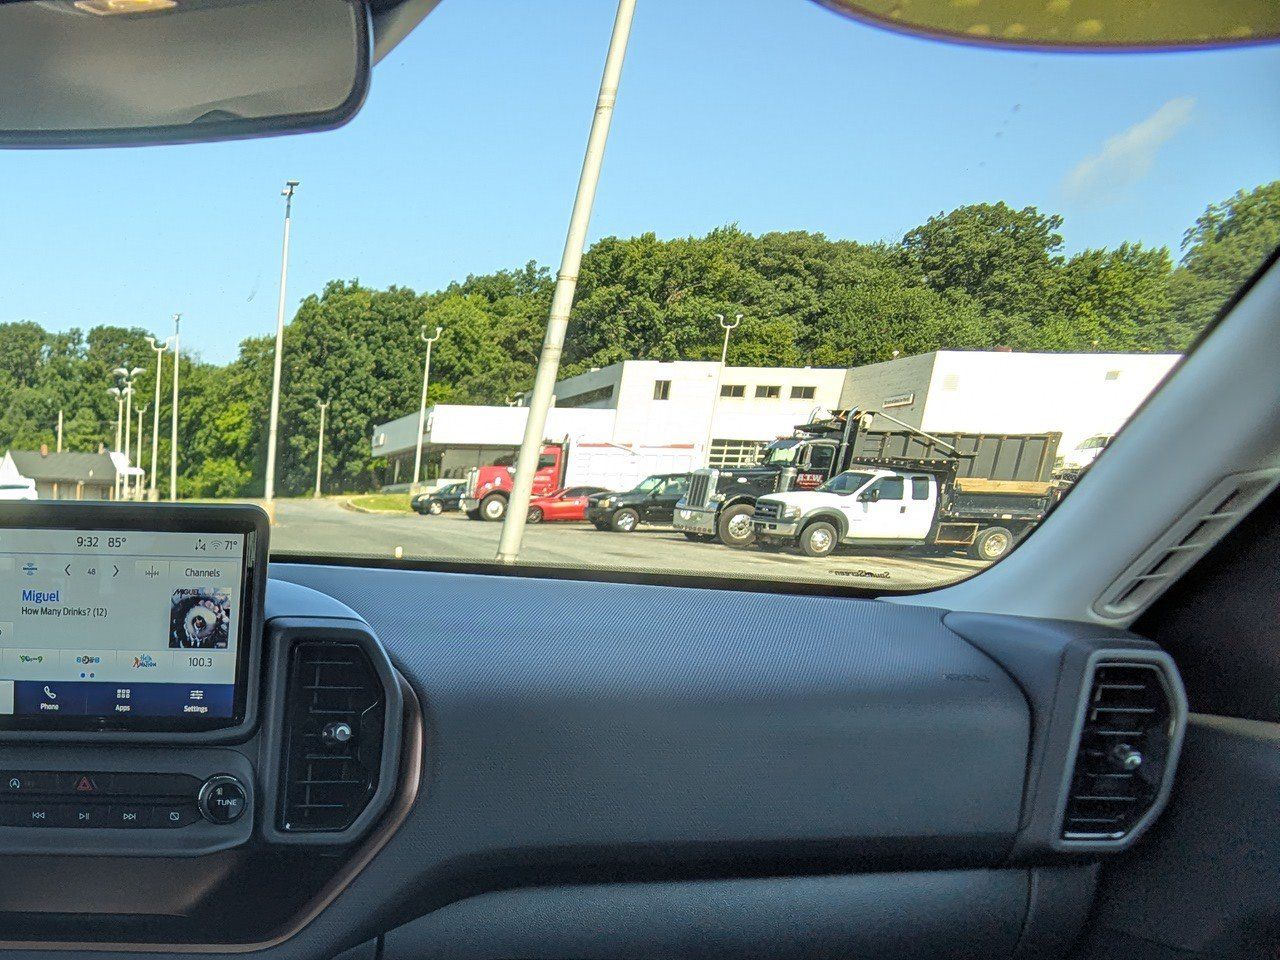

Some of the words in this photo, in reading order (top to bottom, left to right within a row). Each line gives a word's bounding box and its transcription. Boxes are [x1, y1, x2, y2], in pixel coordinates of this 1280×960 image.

[76, 536, 99, 547] 9:32
[107, 537, 127, 548] 85°
[224, 540, 238, 550] 71°
[87, 568, 96, 576] 48
[185, 567, 221, 577] Channels
[22, 589, 60, 604] Miguel
[21, 606, 40, 615] How
[40, 606, 61, 617] Many
[62, 607, 91, 617] Drinks?
[92, 608, 108, 618] (12)
[188, 657, 214, 668] 100.3
[40, 702, 59, 711] Phone
[115, 704, 131, 713] Apps
[183, 705, 209, 714] Settings
